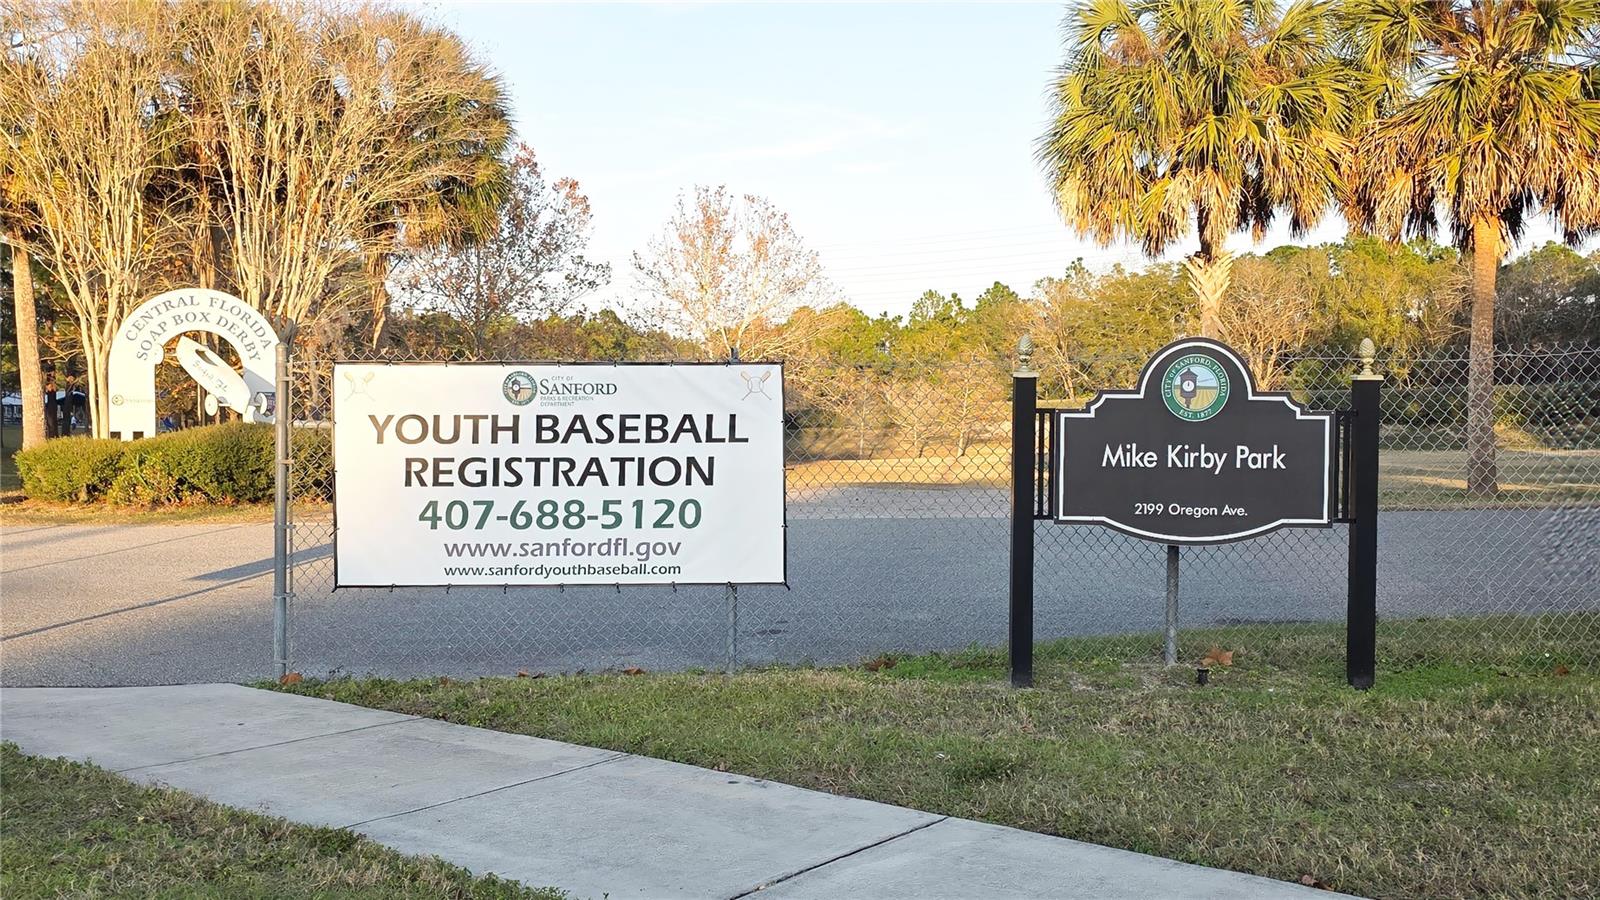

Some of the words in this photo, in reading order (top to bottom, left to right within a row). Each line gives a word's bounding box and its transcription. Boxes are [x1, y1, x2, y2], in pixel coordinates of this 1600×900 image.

[125, 295, 200, 341] CENTRAL
[209, 297, 272, 349] FLORIDA
[136, 321, 168, 361] SOAP
[171, 311, 211, 326] BOX
[216, 315, 261, 361] DERBY
[540, 378, 617, 395] SANFORD
[1164, 378, 1172, 398] CITY
[1212, 365, 1227, 397] FLORIDA
[368, 414, 520, 445] YOUTH
[536, 413, 750, 444] BASEBALL
[1179, 409, 1195, 419] EST.
[1197, 409, 1212, 419] 1877
[404, 456, 715, 487] REGISTRATION
[1101, 443, 1158, 468] Mike
[1167, 444, 1228, 475] Kirby
[1235, 445, 1287, 470] Park
[418, 499, 702, 530] 407-688-5120
[1134, 503, 1164, 515] 2199
[1168, 504, 1218, 518] Oregon
[1221, 505, 1248, 516] Ave.
[444, 537, 682, 562] www.sanfordfl.gov
[444, 563, 681, 579] www.sanfordyouthbaseball.com
